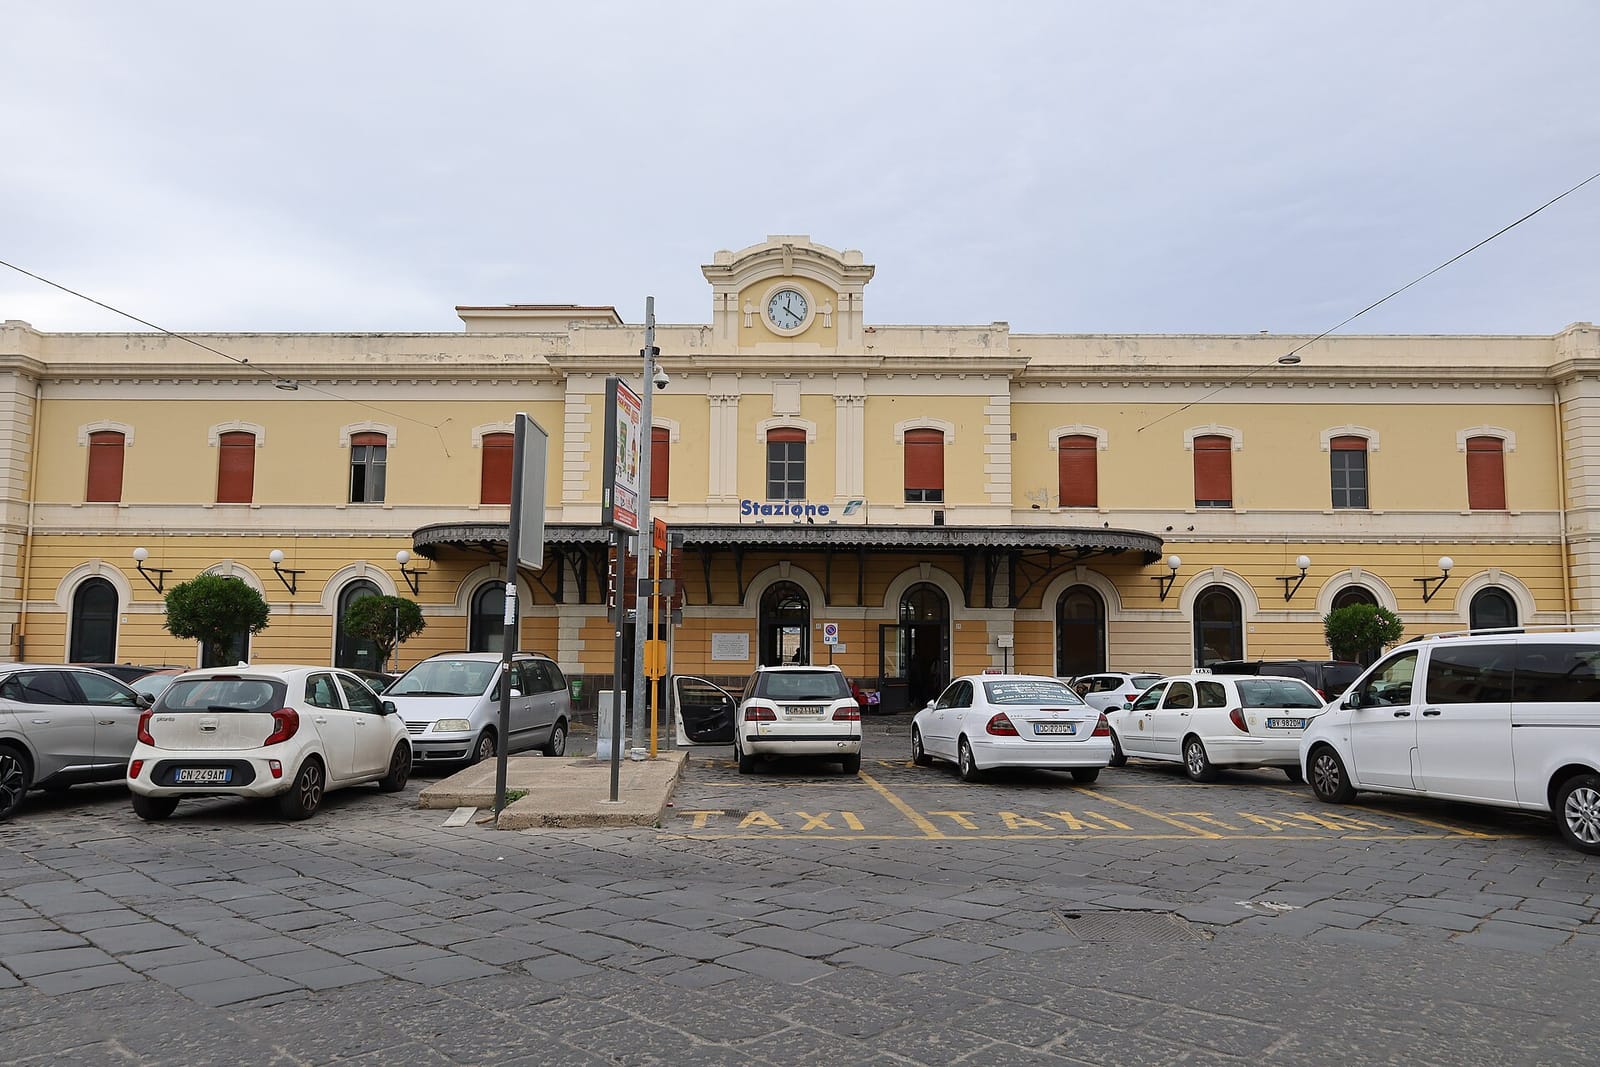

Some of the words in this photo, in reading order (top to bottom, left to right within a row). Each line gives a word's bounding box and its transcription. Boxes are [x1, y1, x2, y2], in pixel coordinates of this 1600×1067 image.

[741, 499, 830, 516] Stazione
[194, 769, 225, 780] 249AM
[676, 810, 865, 831] TAXI
[926, 810, 1134, 830] TAXI
